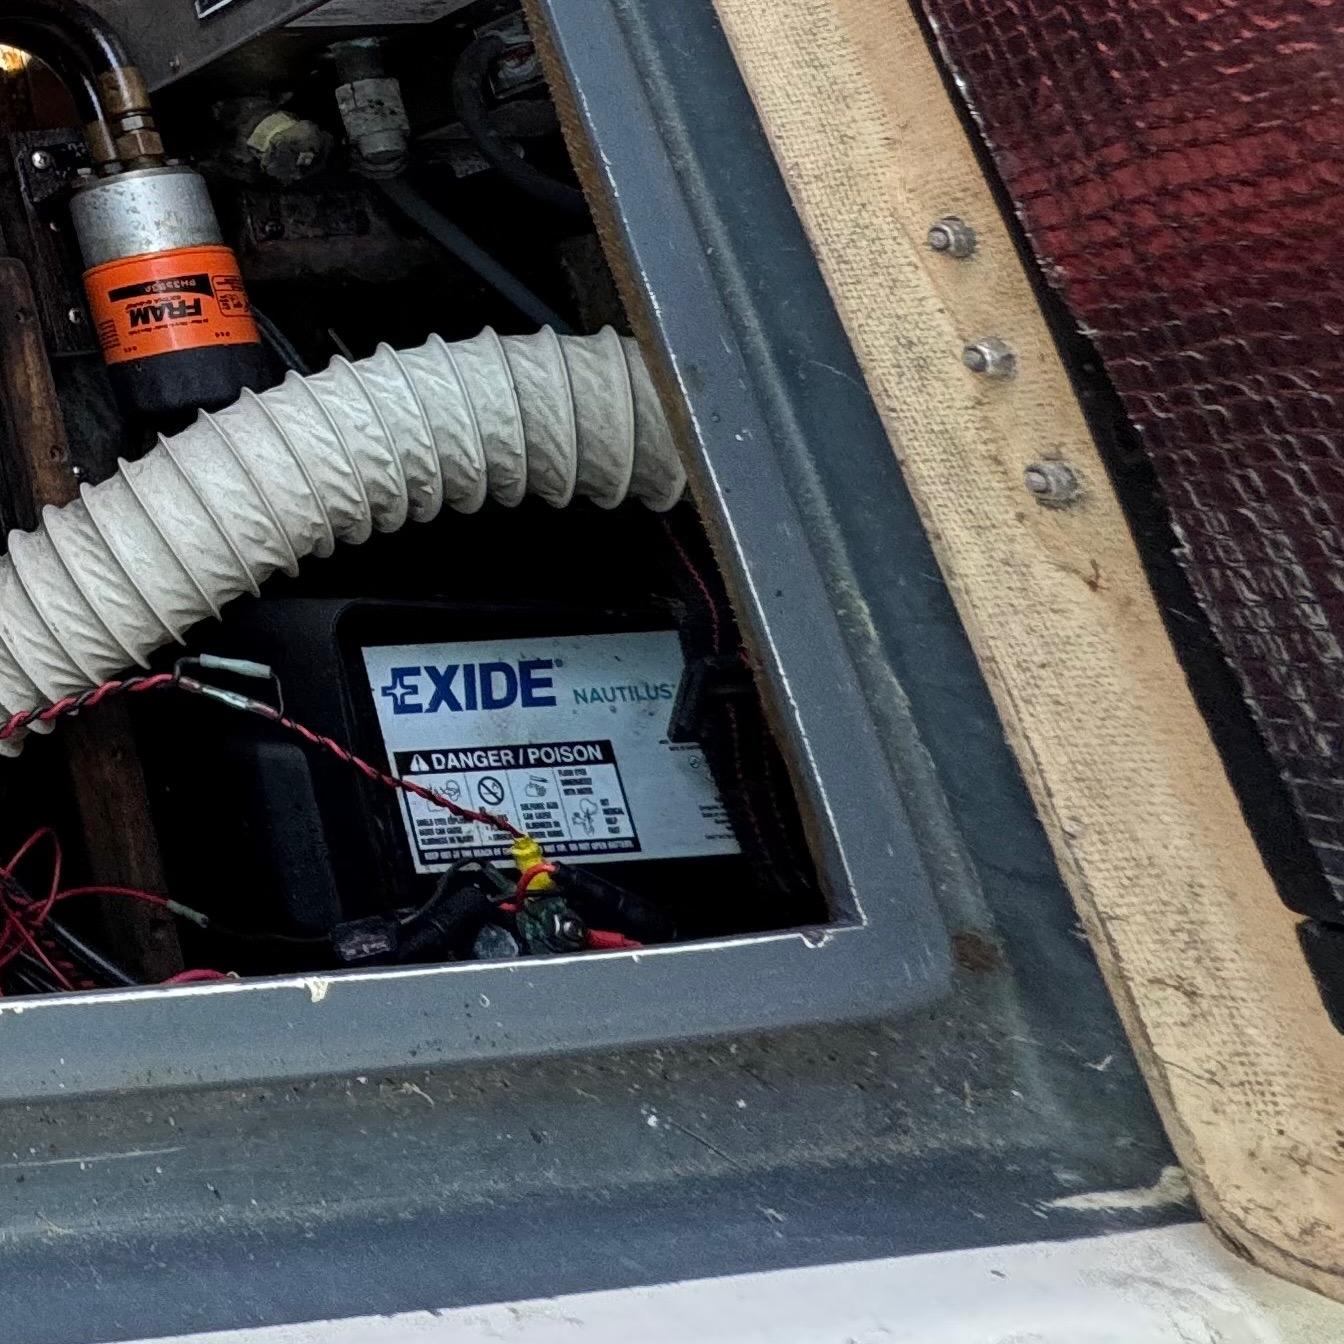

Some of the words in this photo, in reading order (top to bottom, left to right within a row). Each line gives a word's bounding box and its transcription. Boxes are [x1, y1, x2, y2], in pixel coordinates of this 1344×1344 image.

[127, 298, 203, 328] FRAM
[381, 659, 557, 715] EXIDE
[573, 683, 673, 705] NAUTILUS
[431, 749, 514, 770] DANGER
[518, 749, 524, 766] /
[528, 744, 603, 764] POISON
